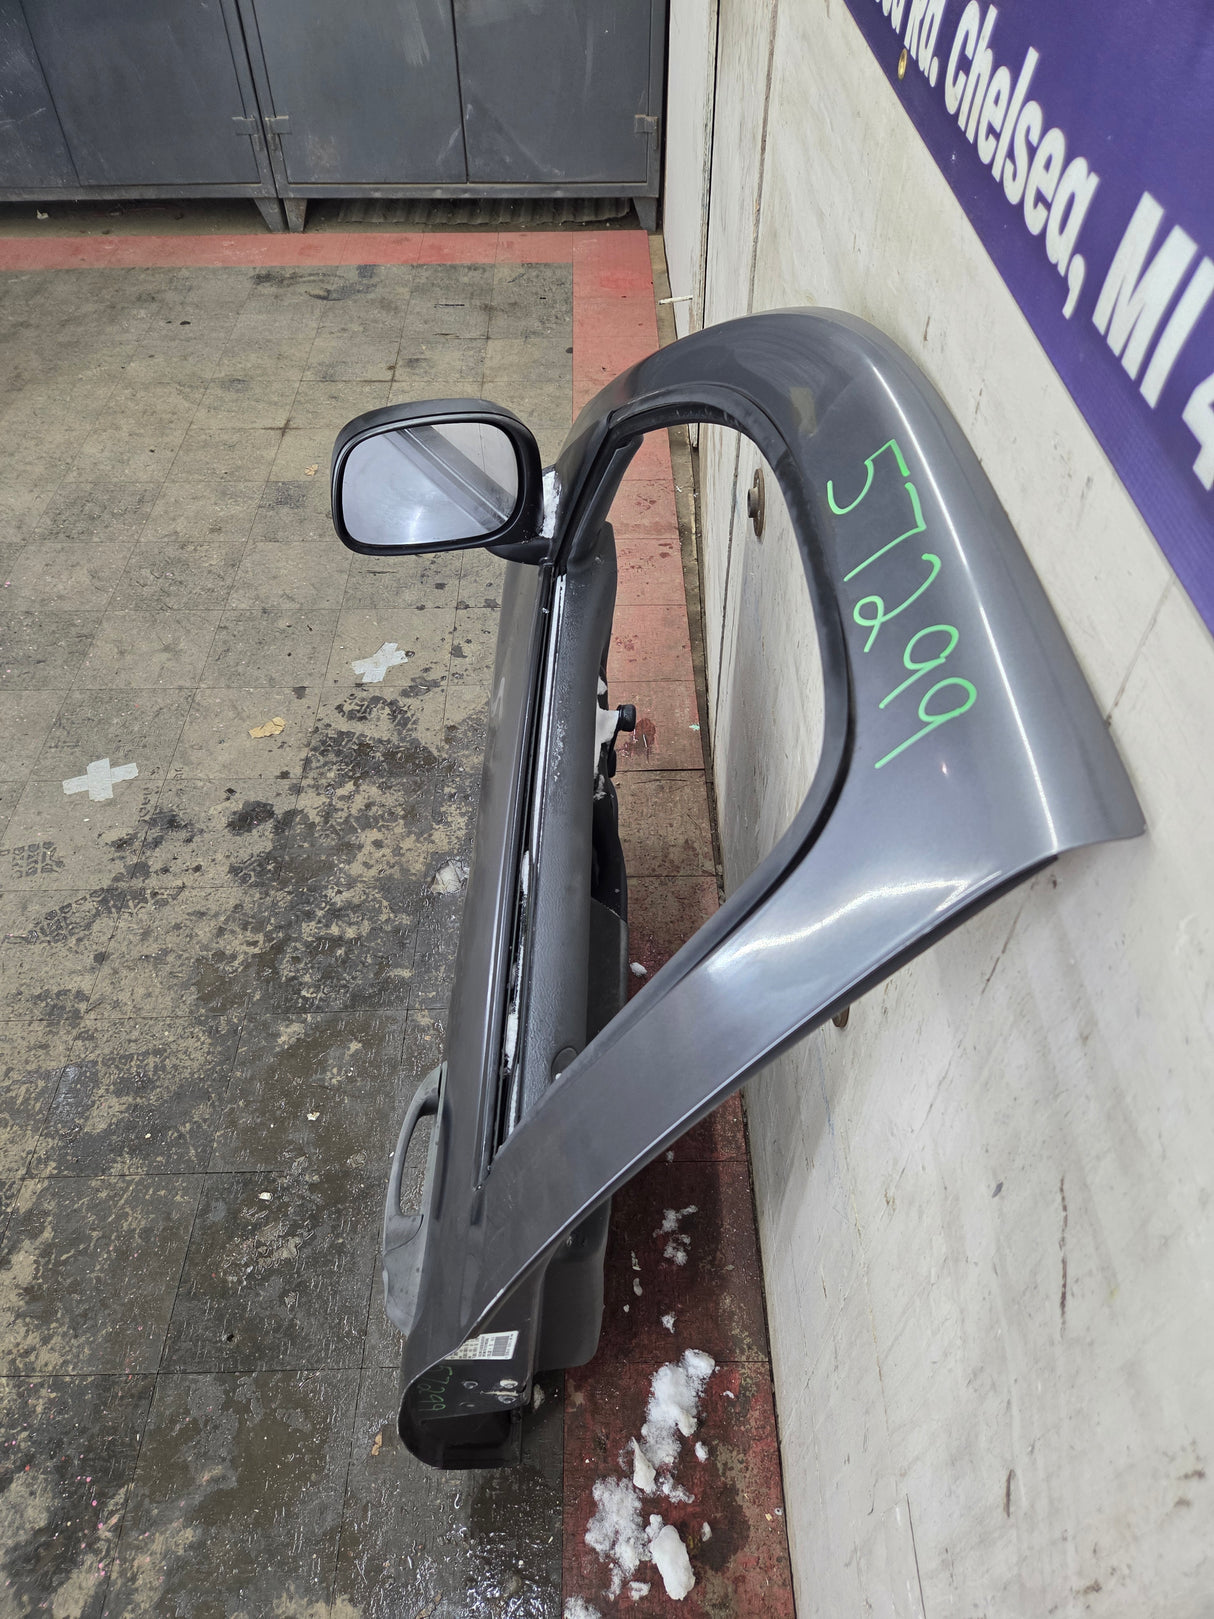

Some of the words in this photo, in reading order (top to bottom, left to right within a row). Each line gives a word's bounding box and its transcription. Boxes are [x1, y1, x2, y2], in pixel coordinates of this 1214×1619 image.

[944, 0, 1100, 320] Chelsea,
[1092, 191, 1214, 409] MI
[826, 438, 977, 769] 57299
